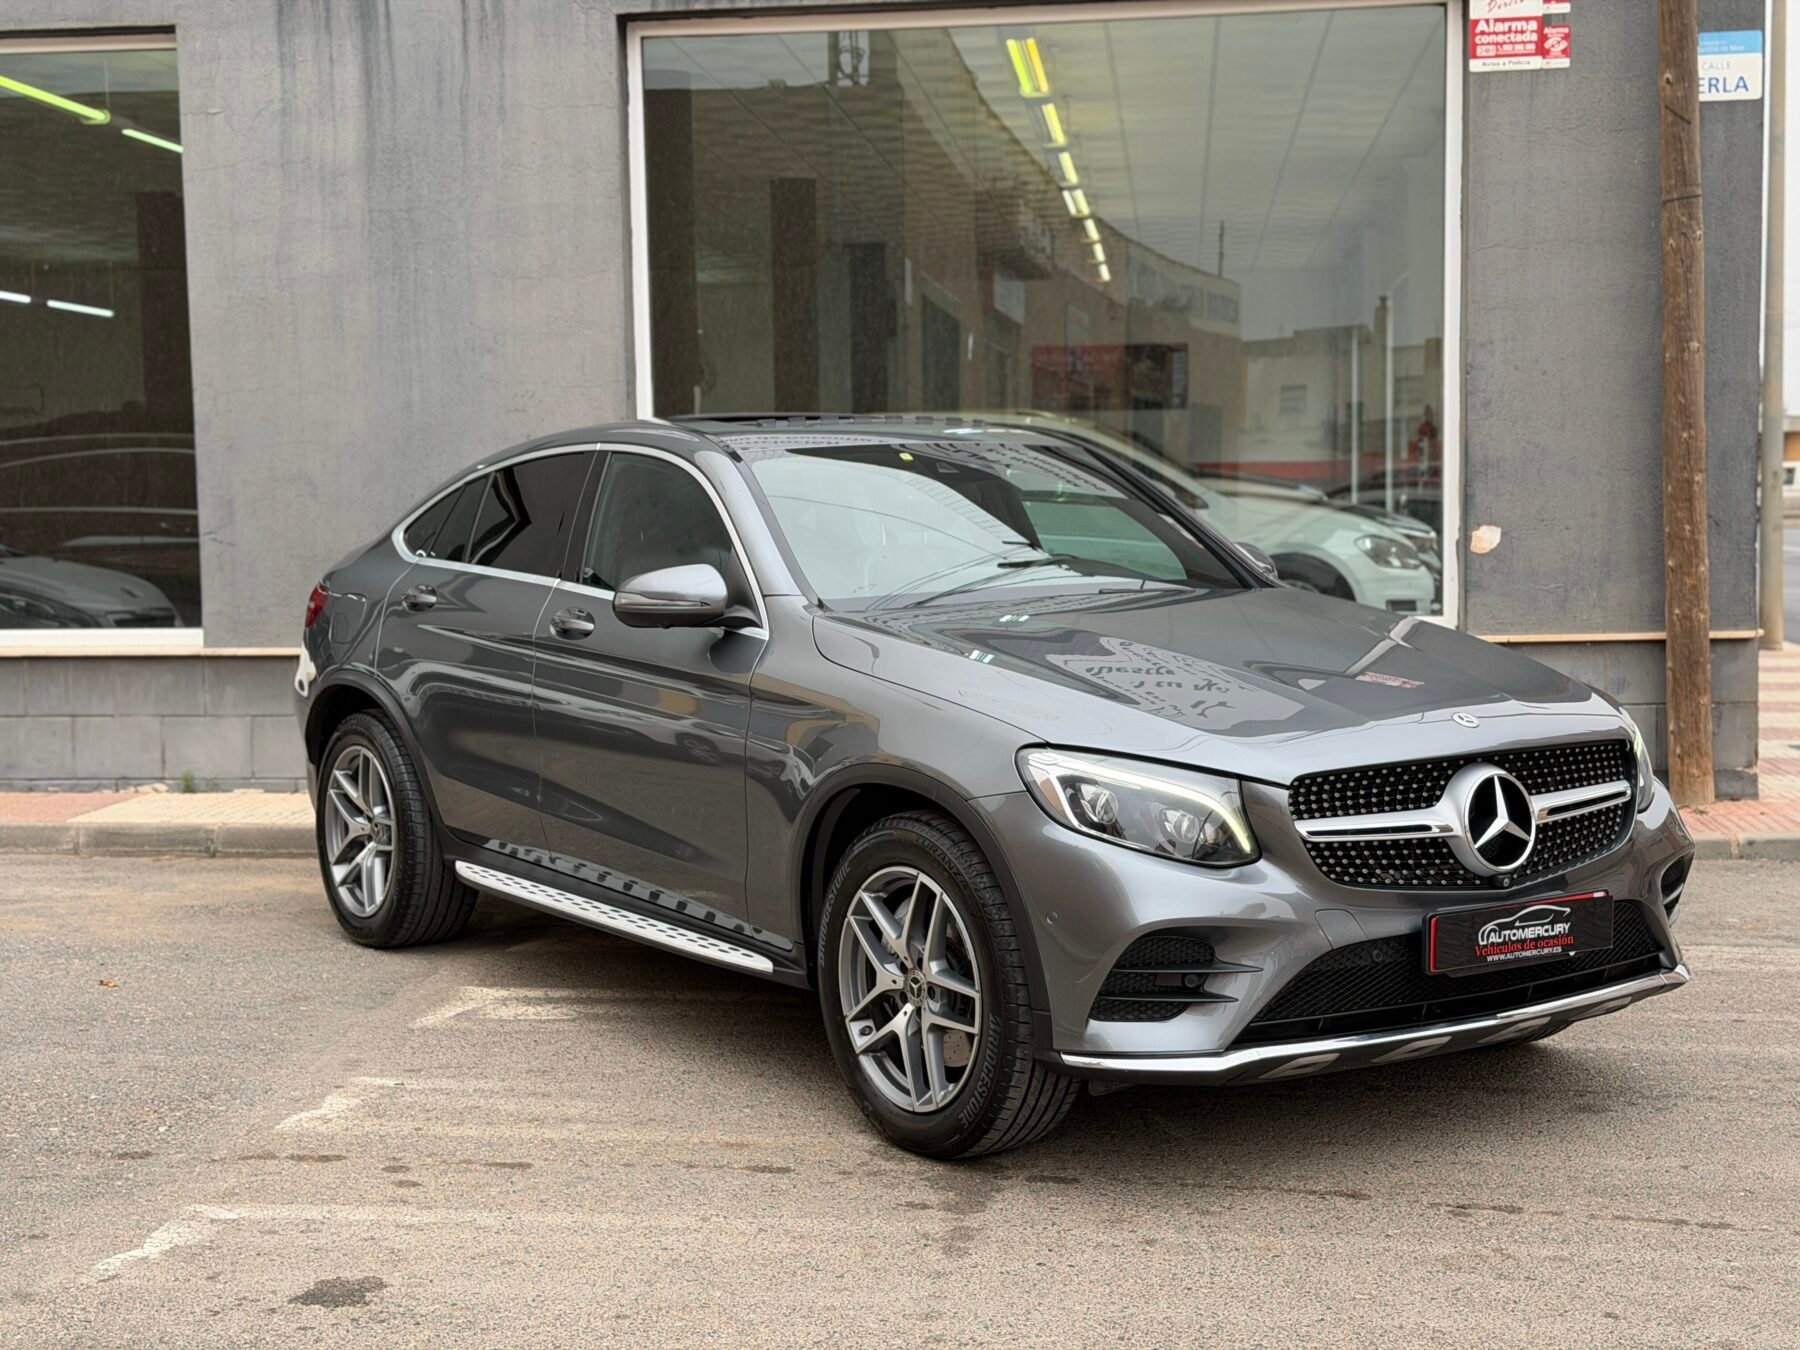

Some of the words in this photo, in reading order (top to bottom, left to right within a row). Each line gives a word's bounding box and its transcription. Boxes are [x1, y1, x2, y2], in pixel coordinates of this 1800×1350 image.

[1475, 19, 1538, 33] Alarma
[1475, 31, 1538, 44] conectada
[1701, 61, 1731, 70] CALLE
[1488, 922, 1571, 944] AUTOMERCURY
[1524, 938, 1535, 949] de
[1537, 934, 1574, 948] ocasión
[1486, 946, 1562, 962] WWW.AUTOMERCURY.ES
